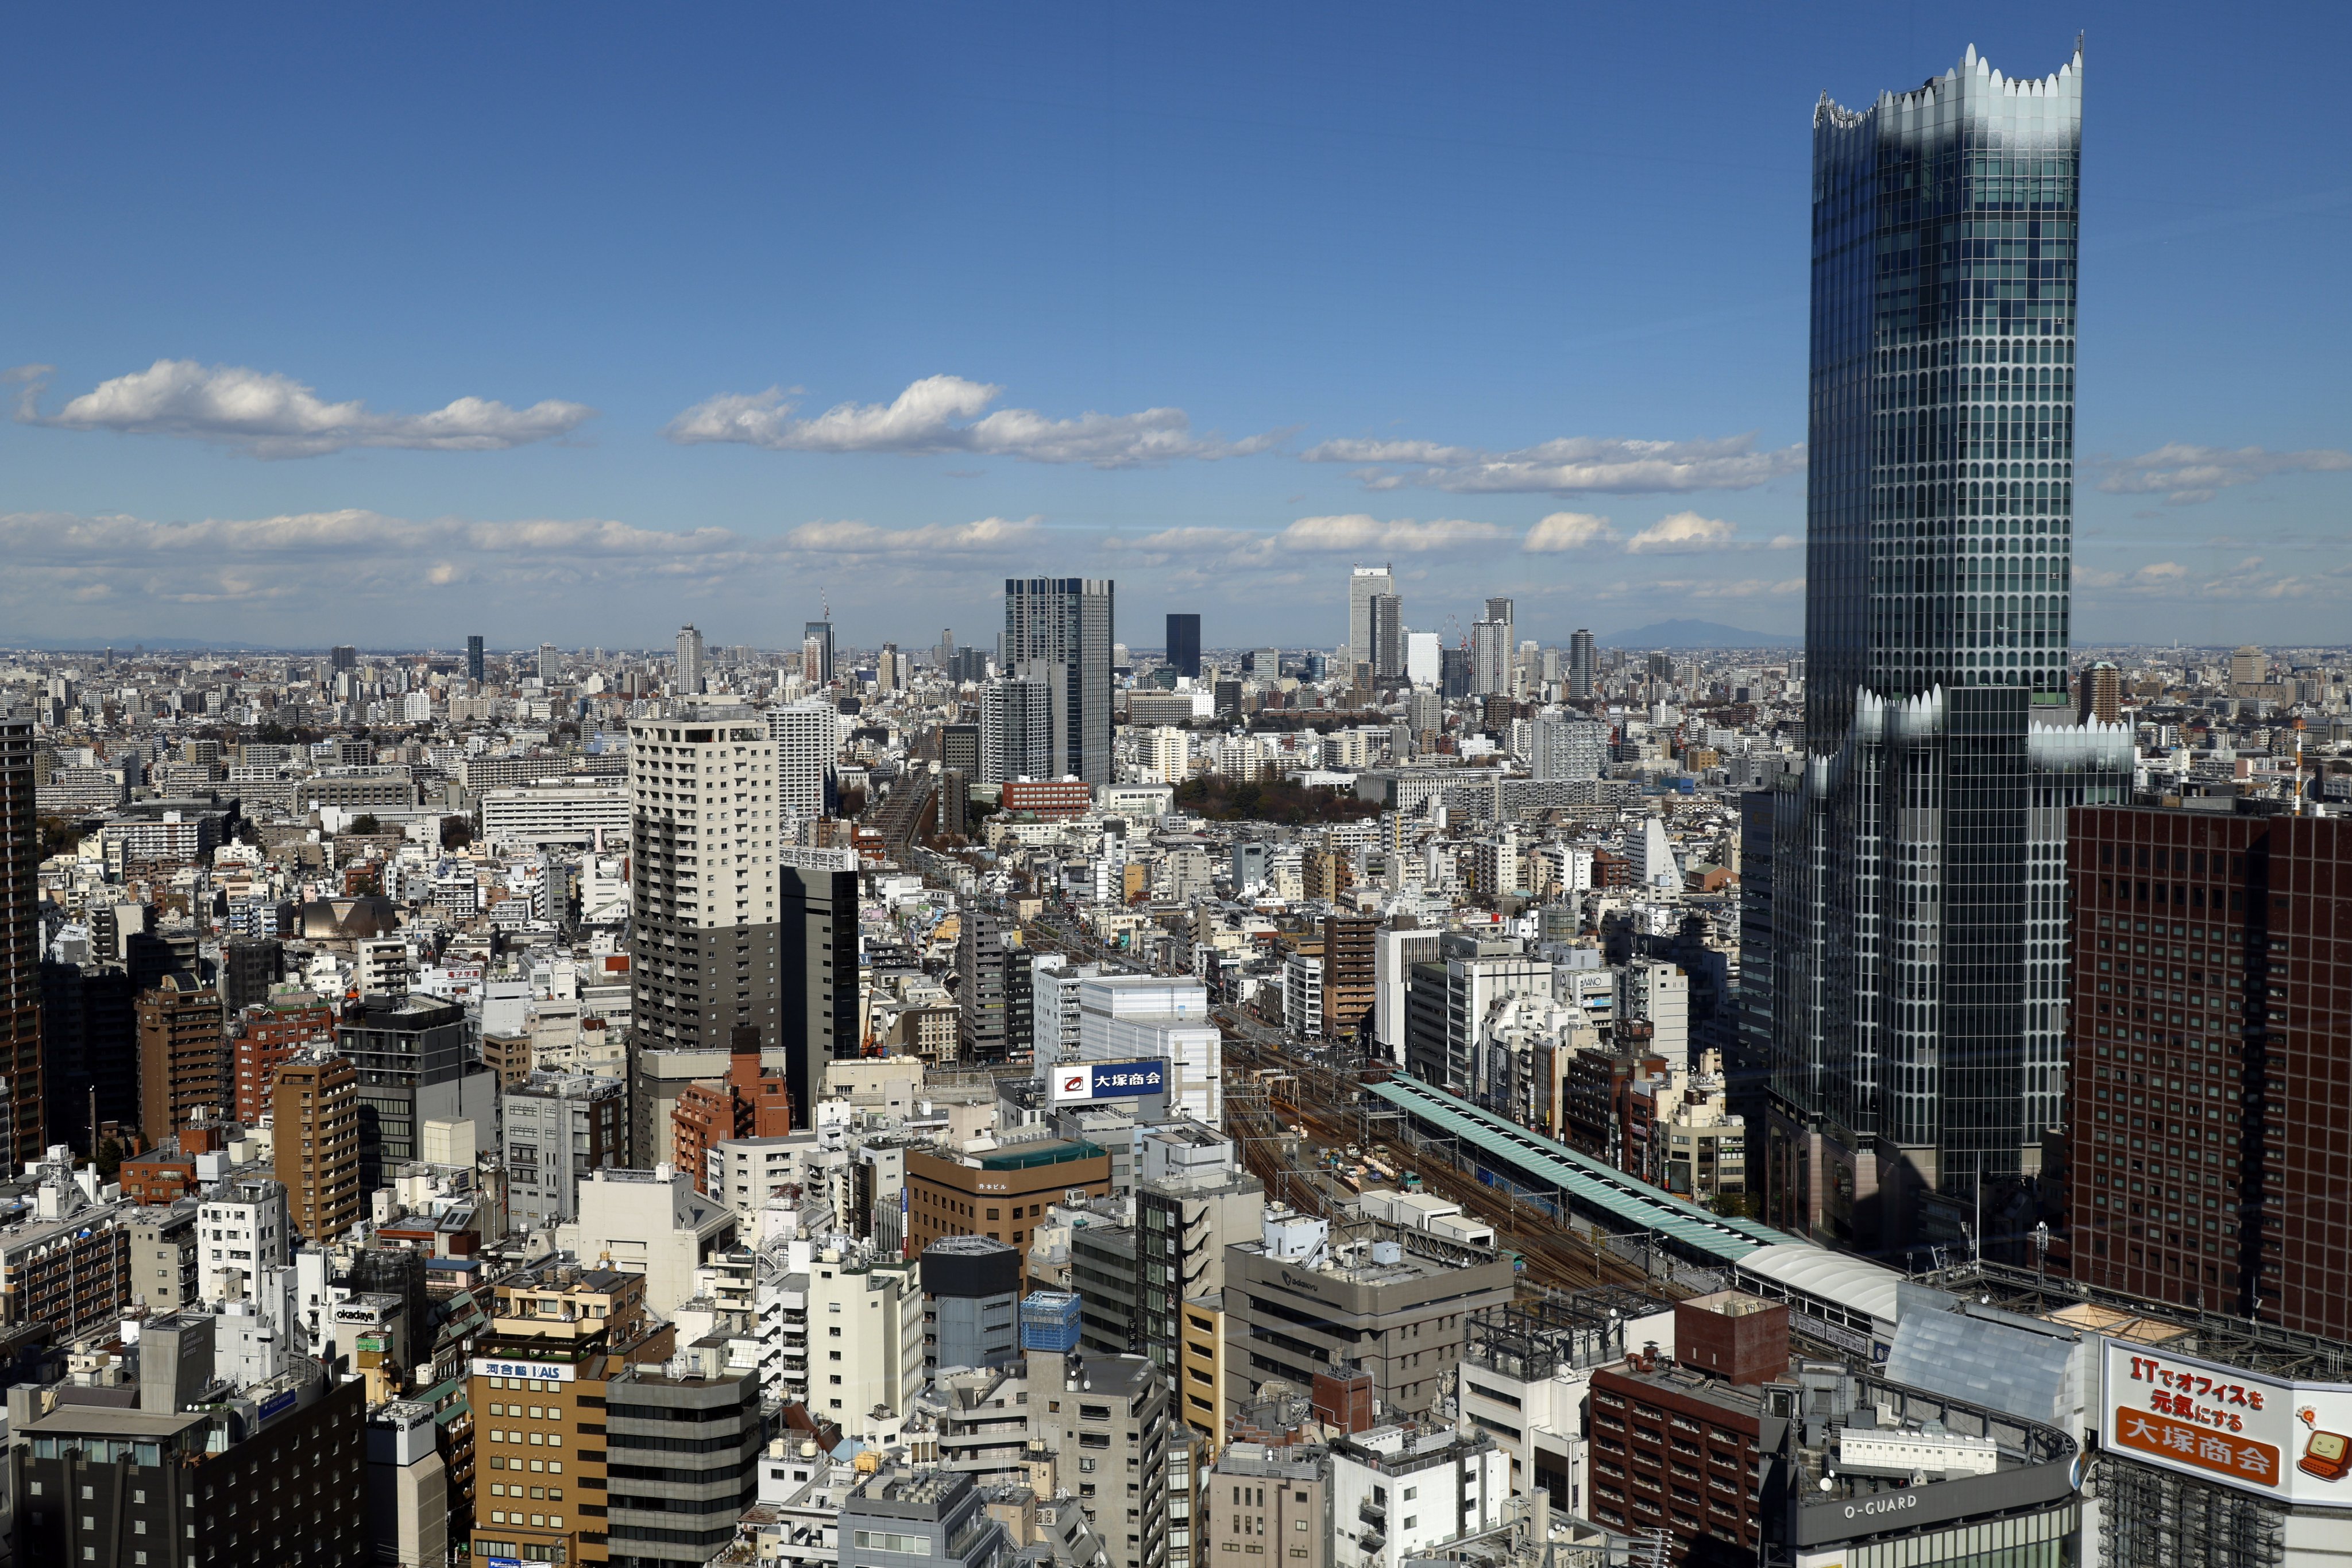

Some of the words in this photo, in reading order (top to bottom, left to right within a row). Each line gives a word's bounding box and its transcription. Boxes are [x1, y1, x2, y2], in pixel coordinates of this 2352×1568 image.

[447, 970, 480, 978] 電子学園
[1094, 1072, 1161, 1088] 大塚商会
[1292, 1278, 1318, 1292] odakyu
[337, 1309, 374, 1322] okadaya
[486, 1364, 527, 1376] 河合塾
[533, 1366, 559, 1378] KALS
[2131, 1356, 2265, 1411] ITでオフィスを
[2150, 1389, 2243, 1432] 元気にする
[366, 1421, 404, 1432] okadaya
[410, 1411, 434, 1430] okadaya
[2126, 1418, 2270, 1474] 大塚商会
[1844, 1495, 1917, 1519] O-GUARD
